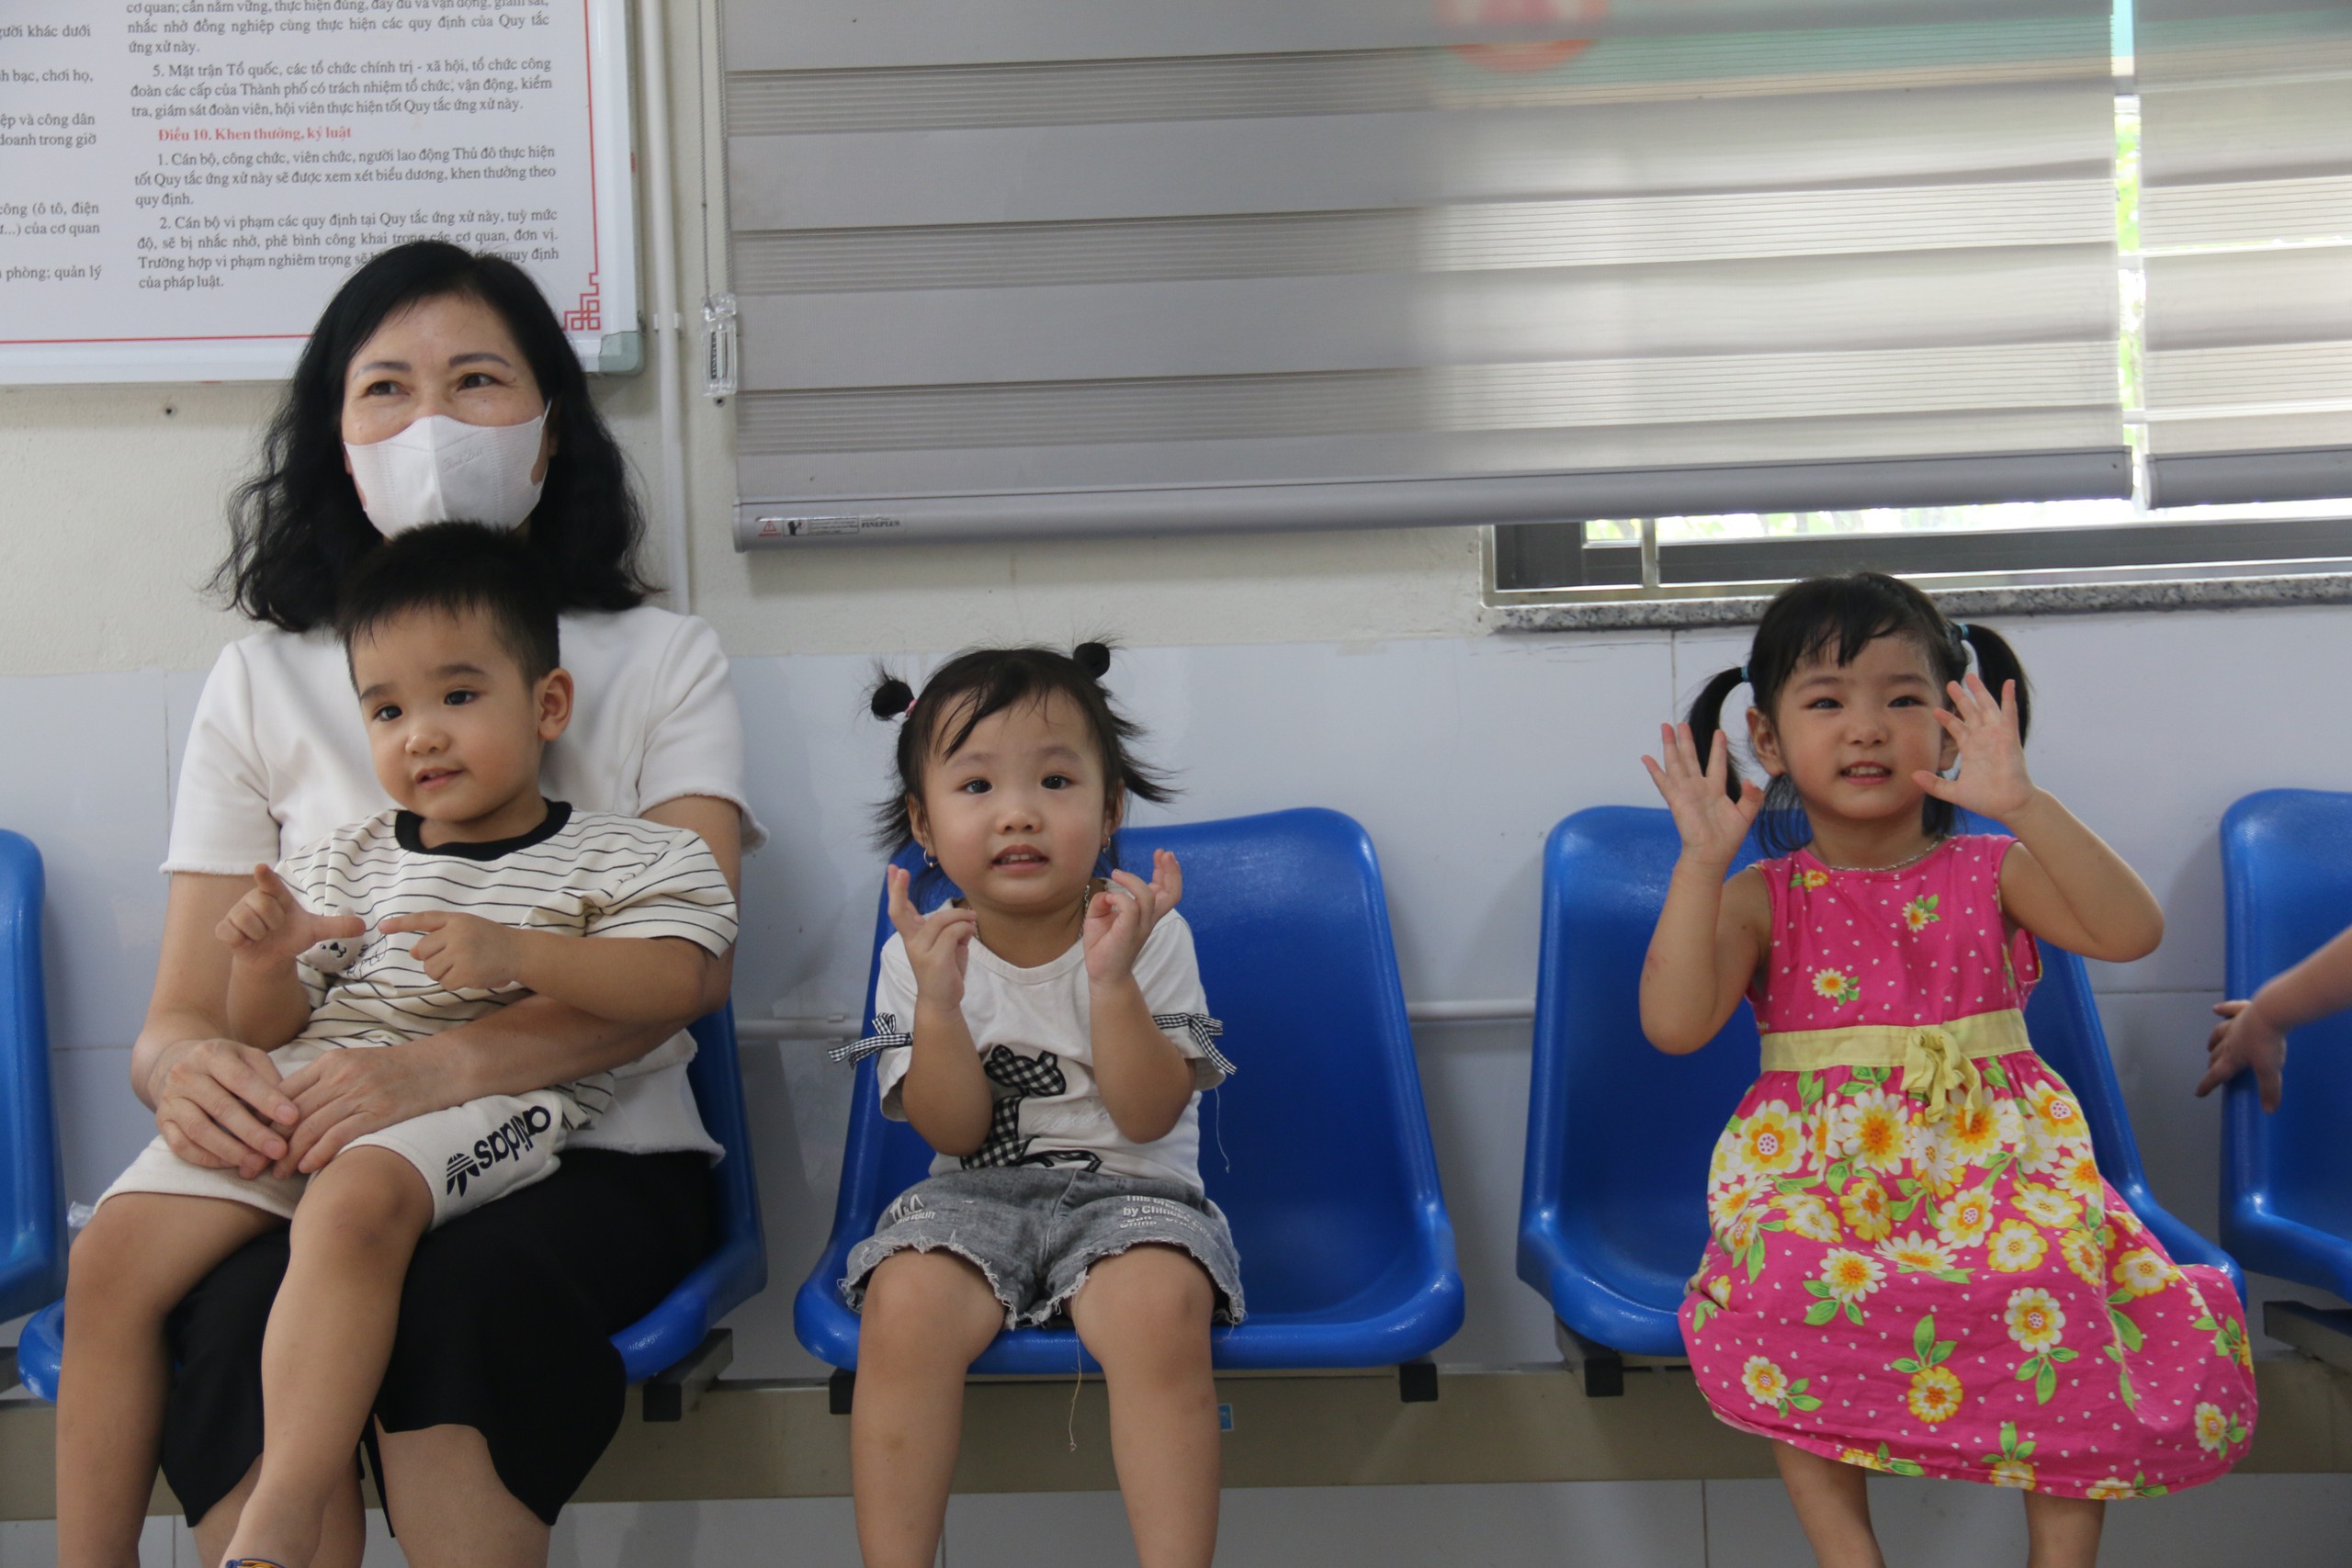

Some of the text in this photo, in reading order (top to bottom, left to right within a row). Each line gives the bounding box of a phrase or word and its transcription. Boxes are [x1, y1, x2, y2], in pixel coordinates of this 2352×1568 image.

[28, 25, 90, 37] khác dưới
[128, 18, 157, 33] nhắc
[232, 19, 275, 35] nghiệp
[280, 19, 311, 34] cùng
[317, 18, 343, 32] thực
[349, 17, 376, 31] hiện
[382, 17, 402, 29] các
[409, 19, 432, 32] quy
[438, 16, 466, 29] định
[499, 14, 525, 29] Quy
[532, 11, 549, 26] tắc
[129, 40, 153, 56] ứng
[42, 69, 69, 81] chơi
[169, 64, 194, 79] Mặt
[198, 64, 222, 78] trận
[287, 62, 307, 74] các
[327, 62, 356, 74] chức
[360, 61, 395, 73] chính
[399, 61, 413, 74] trị
[426, 61, 441, 72] xã
[488, 58, 517, 70] chức
[521, 58, 551, 73] công
[130, 85, 162, 96] đoàn
[164, 85, 187, 96] các
[240, 83, 280, 96] Thành
[284, 81, 308, 98] phố
[311, 82, 326, 94] có
[328, 81, 360, 94] trách
[363, 81, 402, 95] nhiệm
[458, 79, 480, 93] vận
[155, 105, 187, 119] giám
[189, 104, 207, 116] sát
[209, 104, 239, 116] đoàn
[276, 103, 295, 117] hội
[298, 102, 324, 114] viên
[327, 102, 354, 115] thực
[356, 101, 383, 115] hiện
[386, 98, 401, 112] tốt
[403, 99, 431, 115] Quy
[434, 96, 451, 111] tắc
[454, 99, 477, 114] ứng
[19, 114, 34, 125] và
[38, 113, 68, 129] công
[73, 113, 95, 125] dân
[40, 133, 96, 148] trong giờ
[215, 129, 251, 140] Khen
[171, 153, 197, 165] Cán
[222, 152, 253, 167] công
[293, 151, 319, 164] viên
[359, 150, 393, 165] người
[397, 149, 416, 161] lao
[419, 148, 449, 164] động
[481, 147, 496, 159] đô
[499, 147, 525, 161] thực
[528, 145, 555, 160] hiện
[134, 171, 152, 186] tốt
[153, 173, 181, 188] Quy
[184, 170, 203, 185] tắc
[206, 173, 230, 187] ứng
[250, 173, 273, 186] này
[276, 172, 289, 183] sẽ
[291, 171, 322, 185] được
[324, 173, 352, 182] xem
[354, 169, 374, 182] xét
[450, 167, 481, 179] khen
[529, 165, 556, 177] theo
[33, 202, 45, 215] (ô
[72, 202, 98, 216] điện
[135, 197, 159, 209] quy
[175, 217, 200, 229] Cán
[204, 216, 220, 231] bộ
[239, 216, 275, 231] phạm
[277, 215, 299, 227] các
[301, 218, 326, 230] quy
[329, 213, 357, 228] định
[360, 213, 377, 227] tại
[379, 212, 407, 227] Quy
[410, 209, 428, 224] tắc
[432, 211, 456, 226] ứng
[531, 209, 558, 220] mức
[51, 224, 66, 234] cơ
[69, 225, 100, 237] quan
[163, 237, 175, 248] sẽ
[181, 236, 192, 250] bị
[198, 233, 227, 248] nhắc
[266, 234, 287, 250] phê
[326, 233, 355, 248] công
[361, 232, 387, 244] khai
[456, 231, 470, 243] cơ
[514, 229, 537, 241] đơn
[138, 256, 185, 271] Trường
[188, 256, 212, 271] hợp
[215, 255, 227, 267] vi
[231, 255, 266, 270] phạm
[268, 254, 315, 269] nghiêm
[319, 255, 352, 268] trọng
[531, 247, 559, 262] định
[90, 265, 102, 280] lý
[164, 276, 195, 291] pháp
[474, 1105, 551, 1169] adidas
